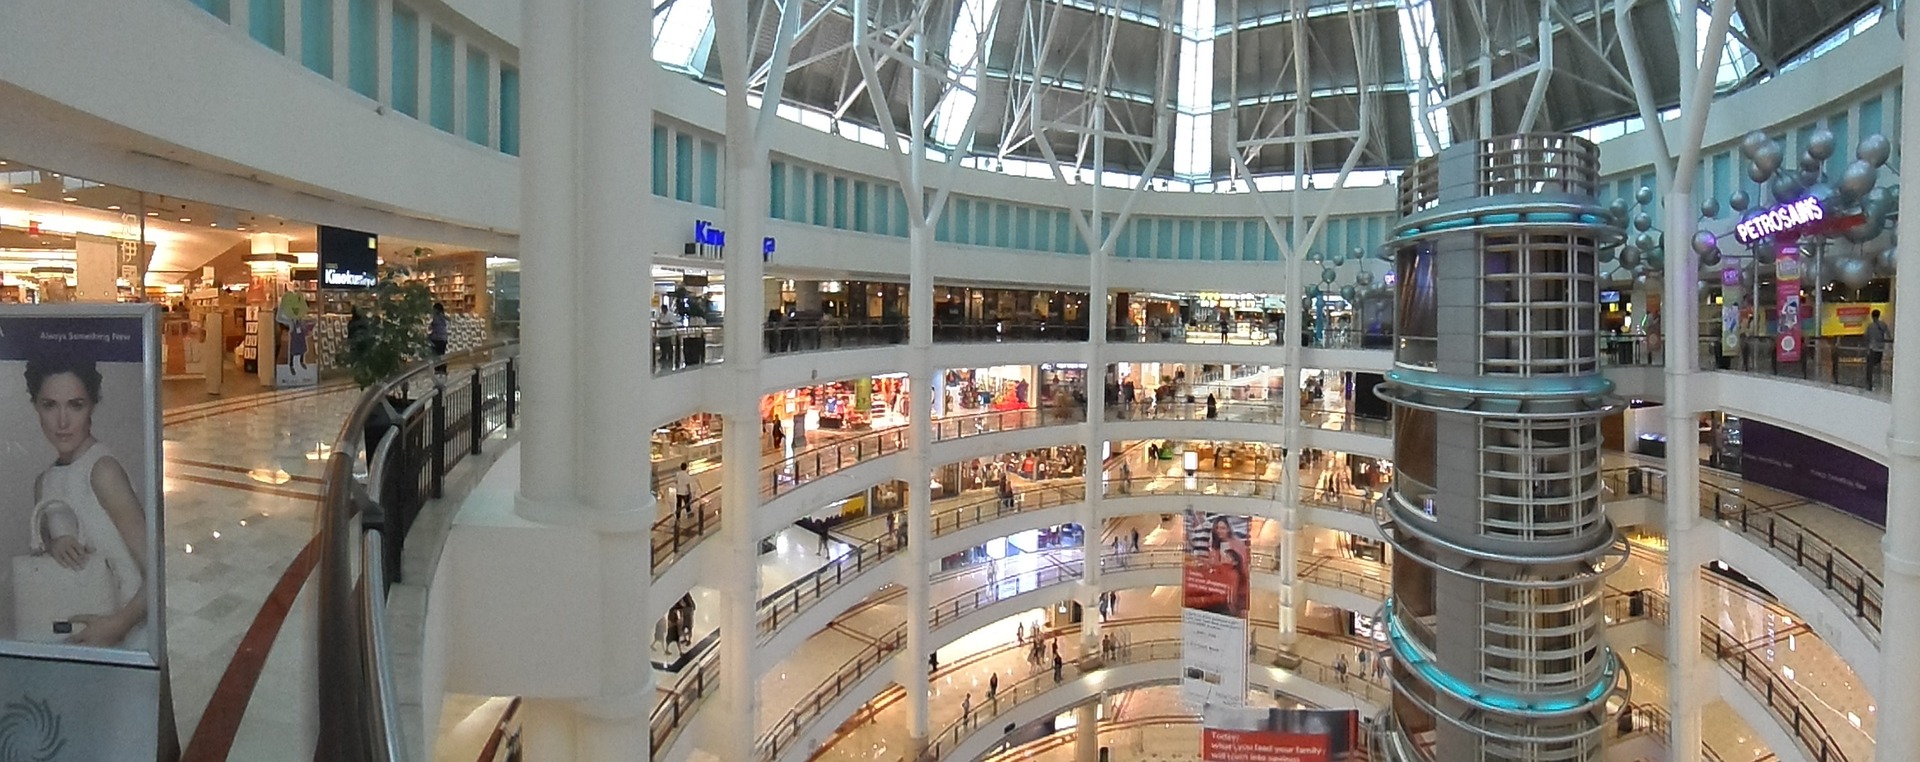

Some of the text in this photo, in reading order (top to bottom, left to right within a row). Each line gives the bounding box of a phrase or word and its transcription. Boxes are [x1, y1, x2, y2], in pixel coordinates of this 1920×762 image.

[1737, 196, 1823, 242] PETROSAINS
[40, 331, 130, 342] Always Something New
[1237, 744, 1253, 752] you
